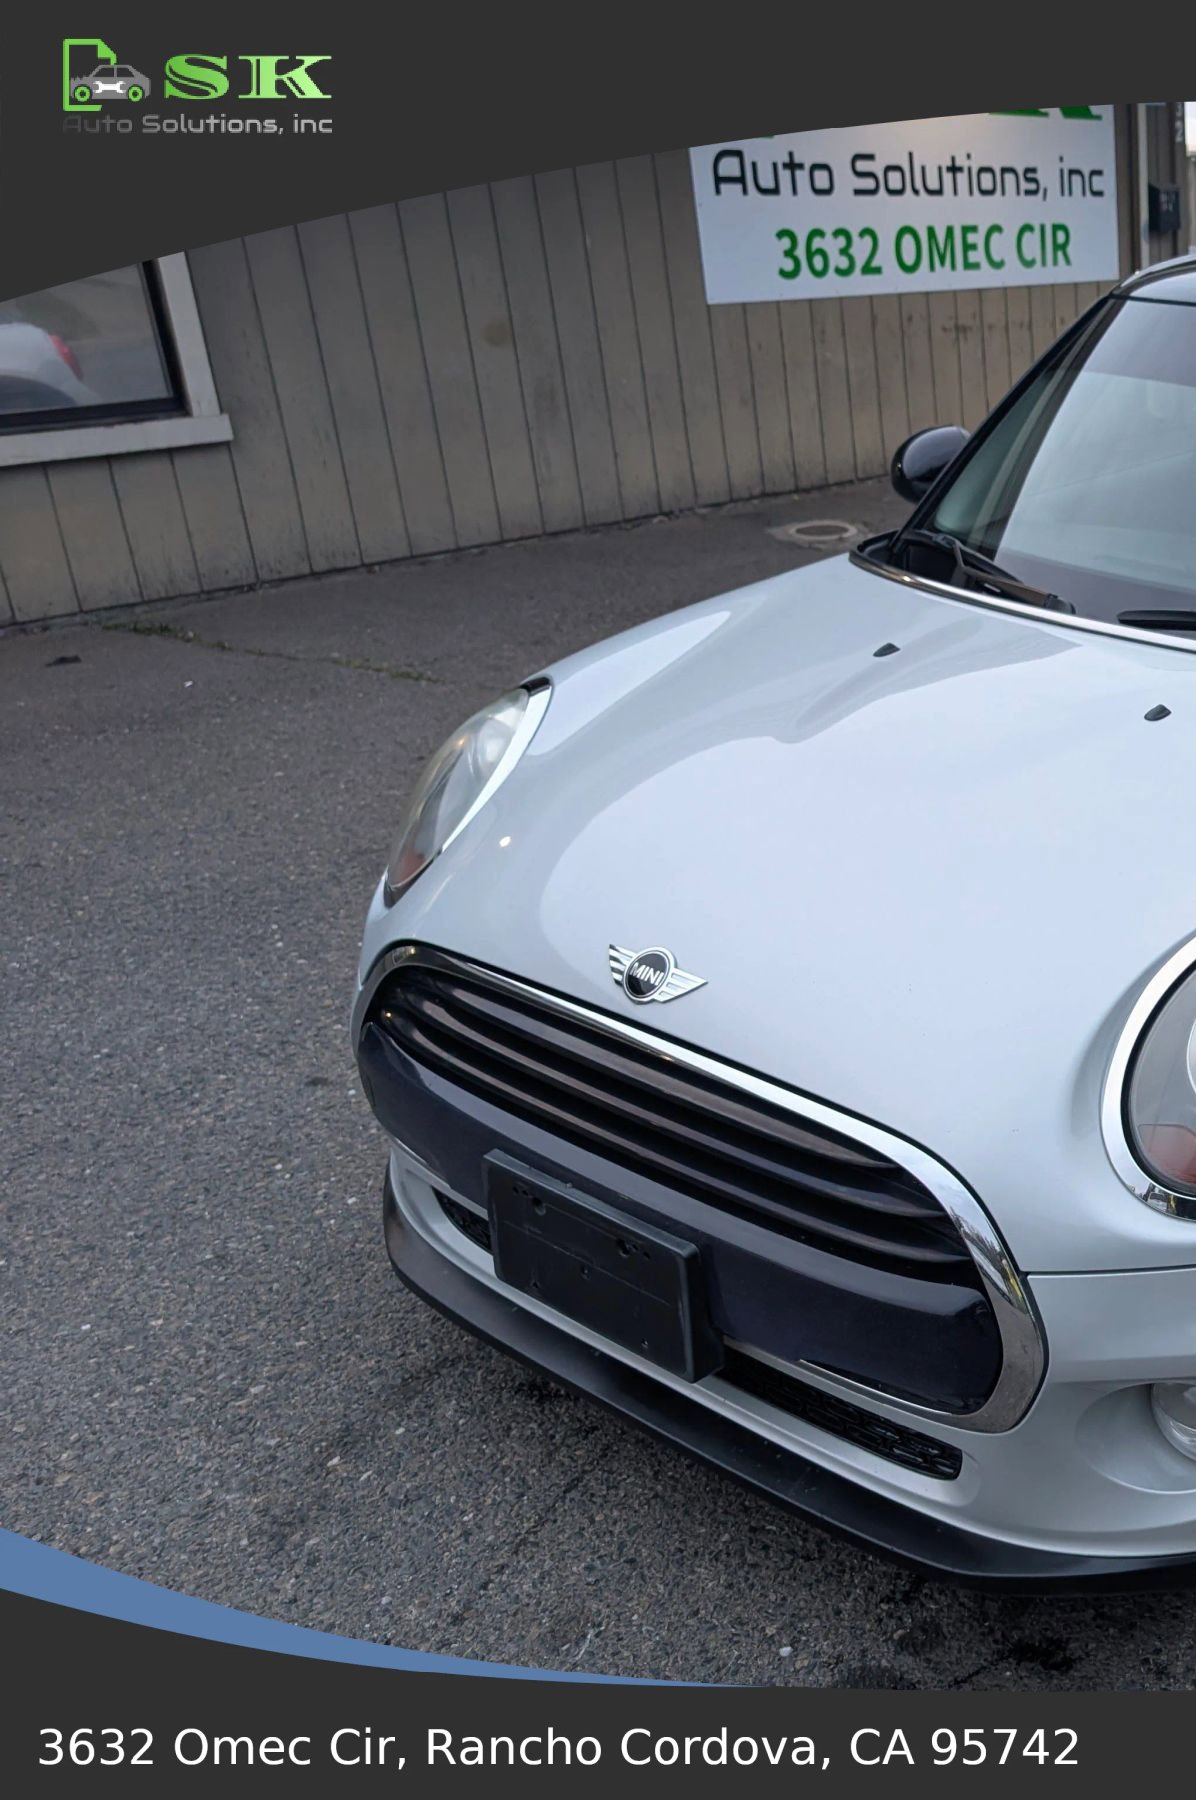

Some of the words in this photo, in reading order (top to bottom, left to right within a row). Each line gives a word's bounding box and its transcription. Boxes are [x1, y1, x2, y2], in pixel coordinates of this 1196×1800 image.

[713, 149, 834, 197] Auto
[851, 151, 1049, 202] Solutions,
[1058, 156, 1104, 198] inc
[775, 227, 883, 280] 3632
[894, 223, 1005, 275] OMEC
[1015, 222, 1073, 269] CIR
[629, 962, 665, 986] MINI
